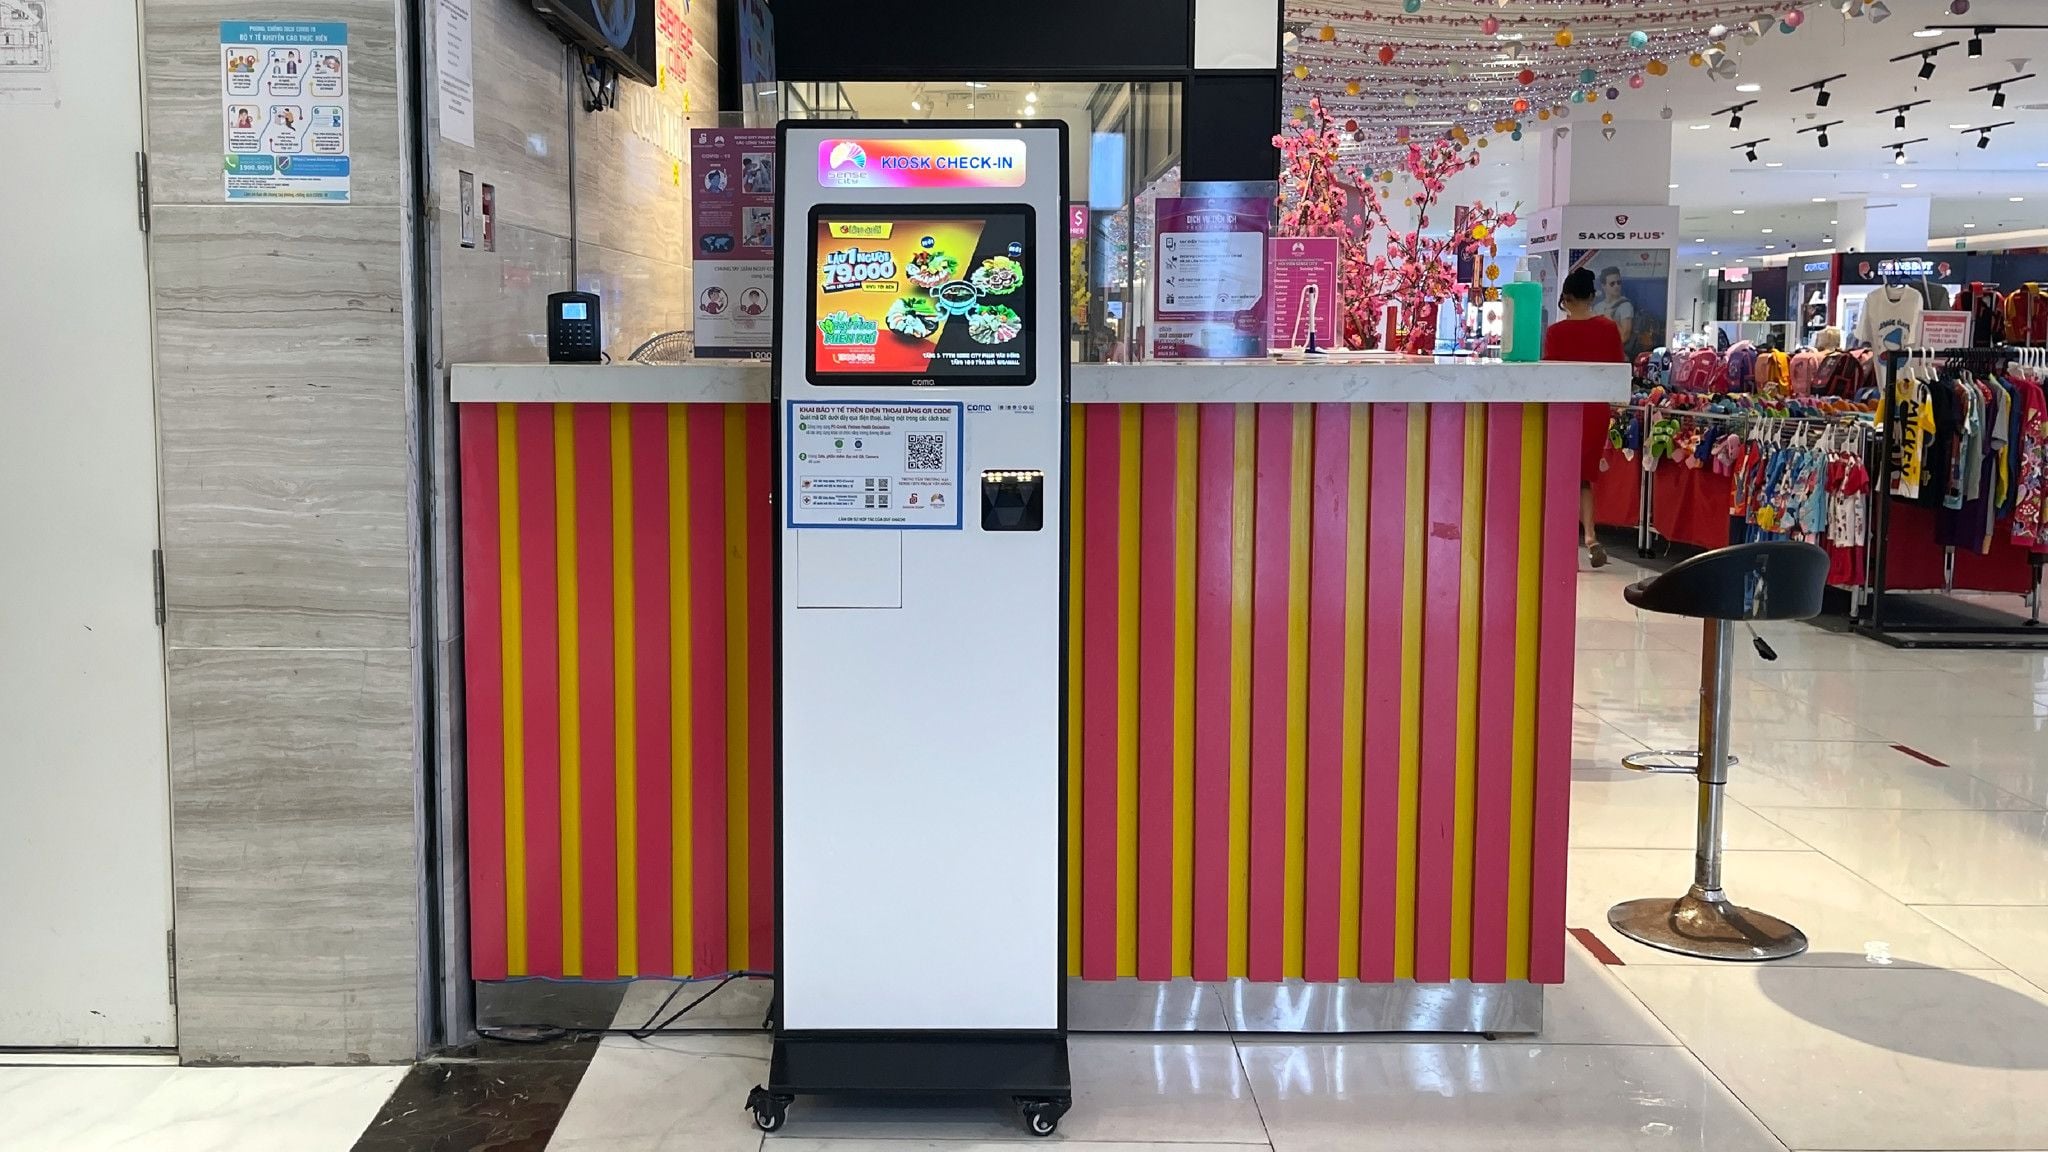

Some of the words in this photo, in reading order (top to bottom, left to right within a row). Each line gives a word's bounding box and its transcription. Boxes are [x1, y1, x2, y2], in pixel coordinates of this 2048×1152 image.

[881, 156, 930, 169] KIOSK
[936, 156, 1013, 169] CHECK-IN
[1578, 232, 1626, 240] SAKOS
[1630, 232, 1661, 240] PLUS
[823, 261, 896, 285] 79.000
[836, 405, 845, 413] TẾ
[882, 407, 902, 415] THOẠI
[1904, 400, 1919, 477] MICKEY
